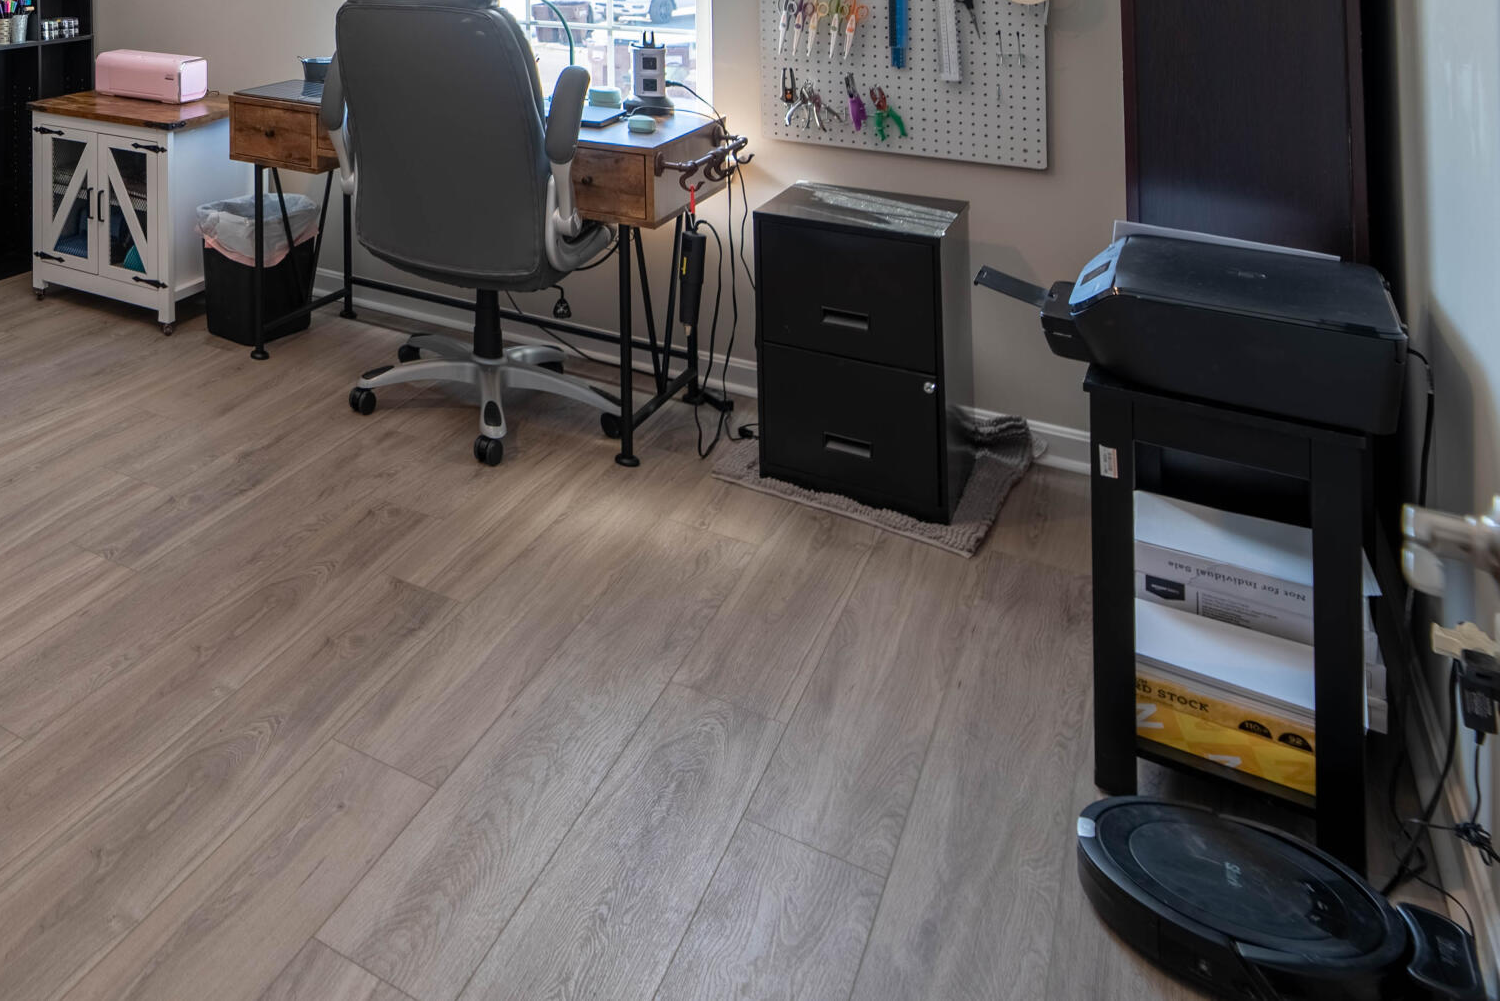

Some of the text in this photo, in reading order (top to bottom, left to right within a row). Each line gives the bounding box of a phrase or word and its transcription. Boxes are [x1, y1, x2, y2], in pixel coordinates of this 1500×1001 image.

[1167, 560, 1307, 602] Not for Individual Sale
[1157, 688, 1211, 713] STOCK
